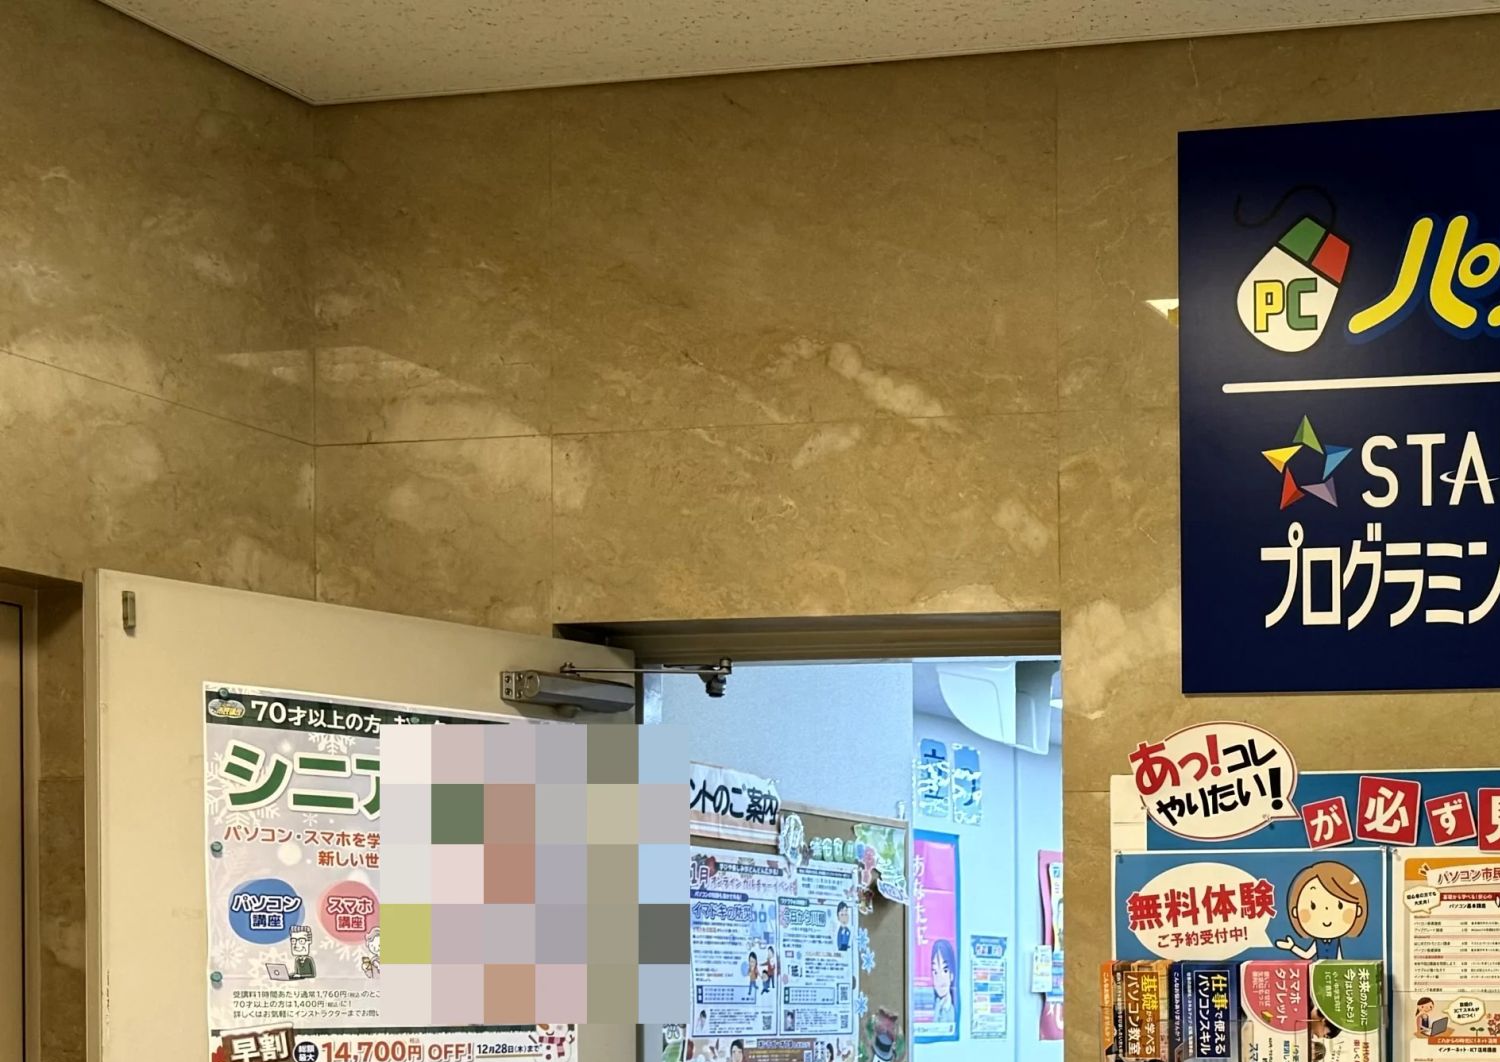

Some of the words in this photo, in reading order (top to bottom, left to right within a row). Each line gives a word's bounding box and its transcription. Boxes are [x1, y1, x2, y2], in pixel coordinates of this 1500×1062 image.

[1254, 281, 1320, 336] PC
[250, 699, 382, 735] 70才以上の方
[232, 893, 301, 913] パソコン
[252, 913, 285, 931] 講座
[326, 895, 375, 914] スマホ
[335, 914, 366, 932] 講座
[1127, 879, 1278, 931] 無料体験
[1157, 926, 1249, 949] ご予約受付中!
[1127, 974, 1141, 1056] パソコン教室
[1141, 974, 1158, 1055] 基礎から学べる
[1198, 974, 1212, 1056] パソコンスキル
[1211, 974, 1229, 1055] 仕事で使える
[1275, 968, 1288, 1025] タブレット
[1358, 967, 1371, 1026] 未来のために
[428, 1042, 474, 1062] OFF!
